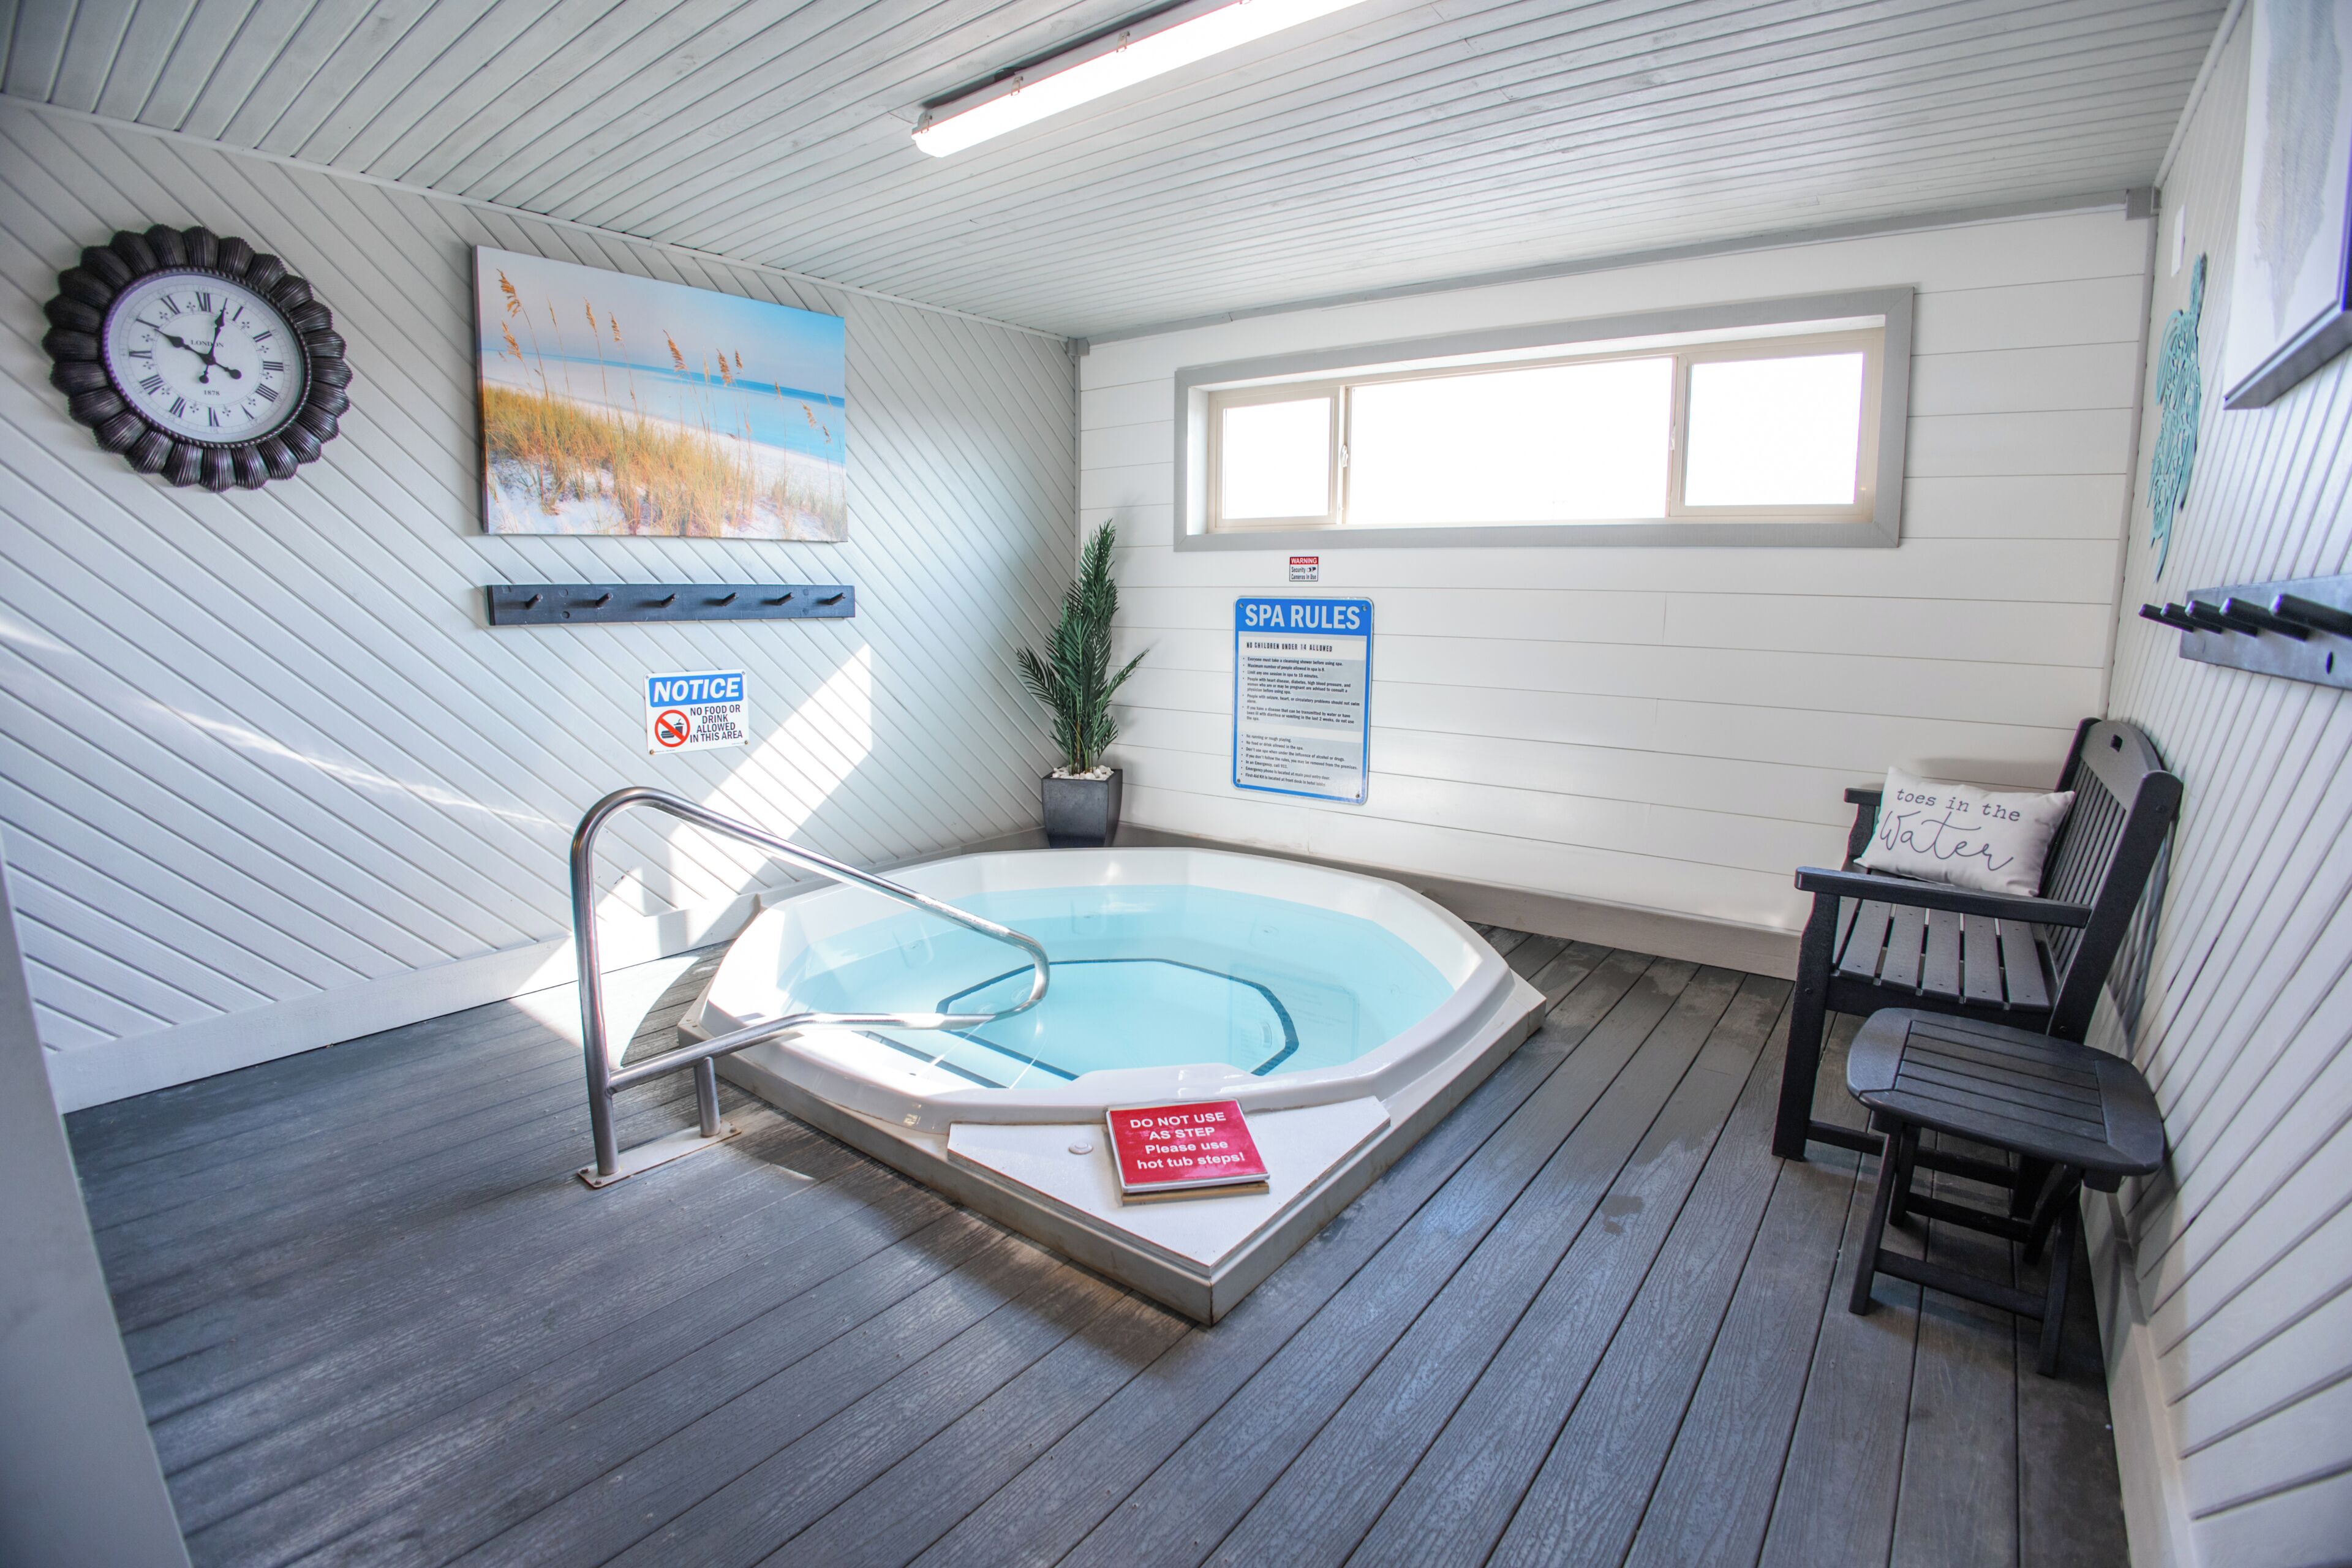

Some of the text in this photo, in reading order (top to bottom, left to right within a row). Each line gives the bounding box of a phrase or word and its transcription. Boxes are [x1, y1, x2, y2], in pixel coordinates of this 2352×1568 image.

[204, 390, 220, 398] 1878
[1245, 604, 1360, 630] SPA RULES
[654, 677, 741, 702] NOTICE
[690, 704, 740, 716] NO FOOD OR
[702, 714, 728, 724] DRINK
[697, 722, 735, 733] ALLOWED
[690, 731, 743, 743] IN THIS AREA
[1896, 788, 2021, 821] toes in the
[1130, 1112, 1226, 1128] DO NOT USE
[1149, 1127, 1215, 1140] AS STEP
[1145, 1141, 1228, 1154] Please use
[1136, 1152, 1245, 1169] hot tub steps!
